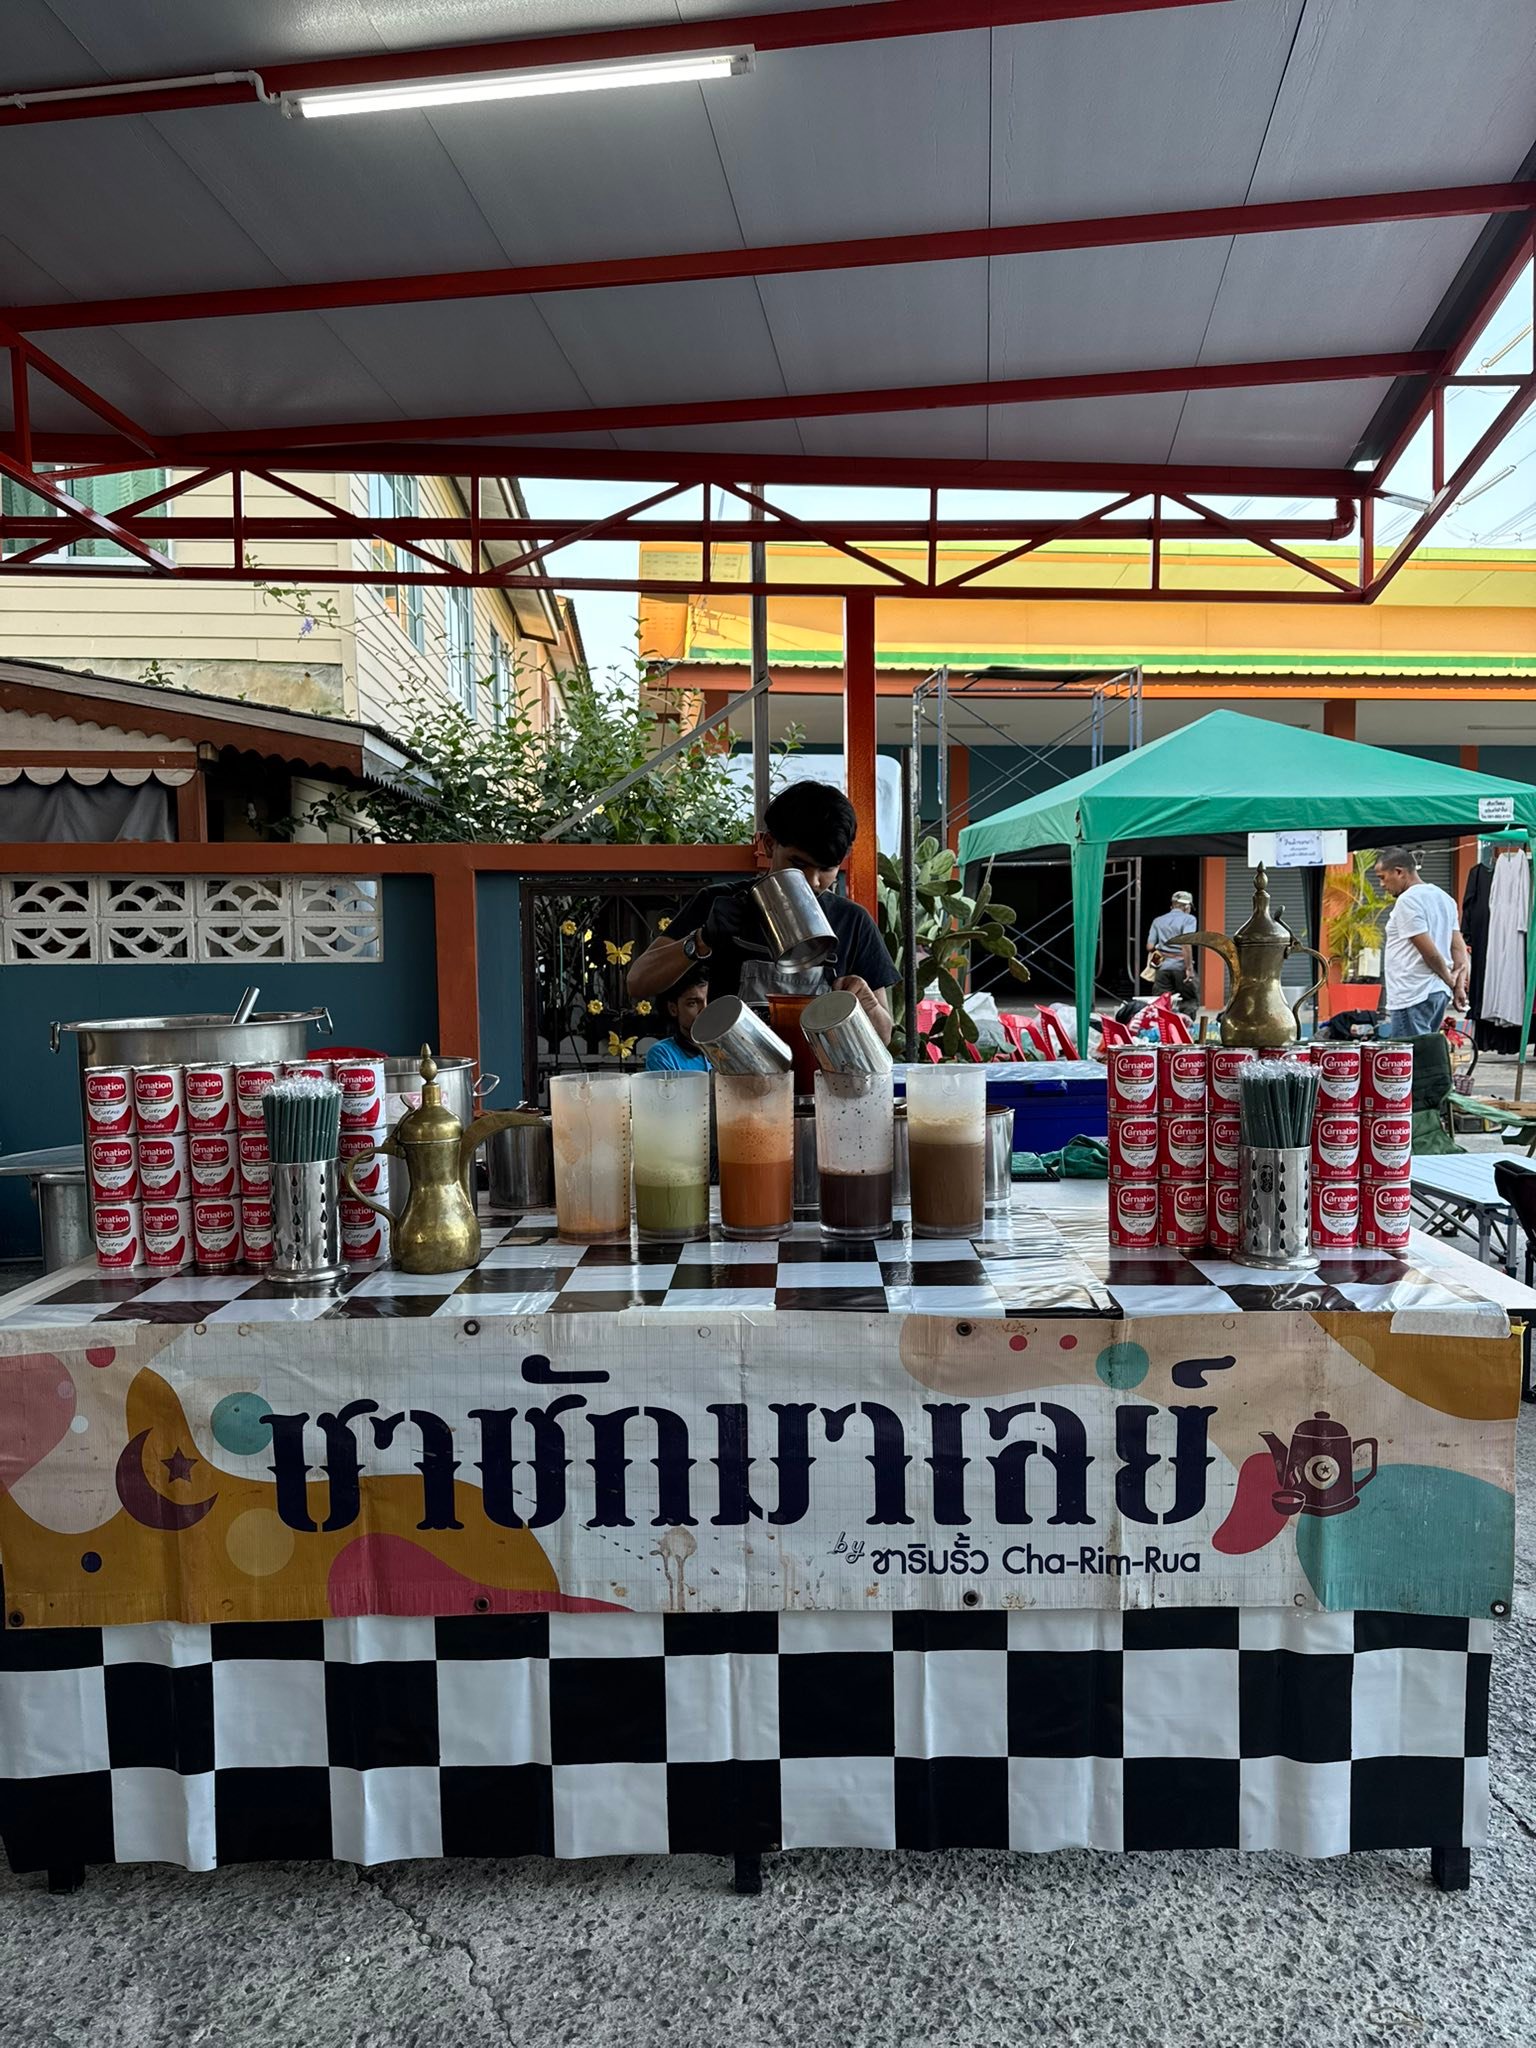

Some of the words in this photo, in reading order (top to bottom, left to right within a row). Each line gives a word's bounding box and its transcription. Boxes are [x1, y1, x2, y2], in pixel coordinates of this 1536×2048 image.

[1118, 1058, 1154, 1072] Carnation
[88, 1080, 125, 1093] Carnation
[136, 1079, 172, 1092] Carnation
[187, 1077, 222, 1090] Carnation
[239, 1075, 274, 1088] Carnation
[338, 1073, 374, 1086] Carnation
[93, 1146, 131, 1160] Carnation
[139, 1144, 173, 1158] Carnation
[191, 1143, 227, 1157] Carnation
[95, 1211, 129, 1226] Carnation
[143, 1210, 178, 1224] Carnation
[197, 1208, 233, 1222] Carnation
[259, 1354, 1236, 1533] ชาชักมาเลย์
[830, 1531, 865, 1564] by
[871, 1532, 989, 1575] ชาริมรั้ว
[1002, 1543, 1201, 1575] Cha-Rim-Rua
